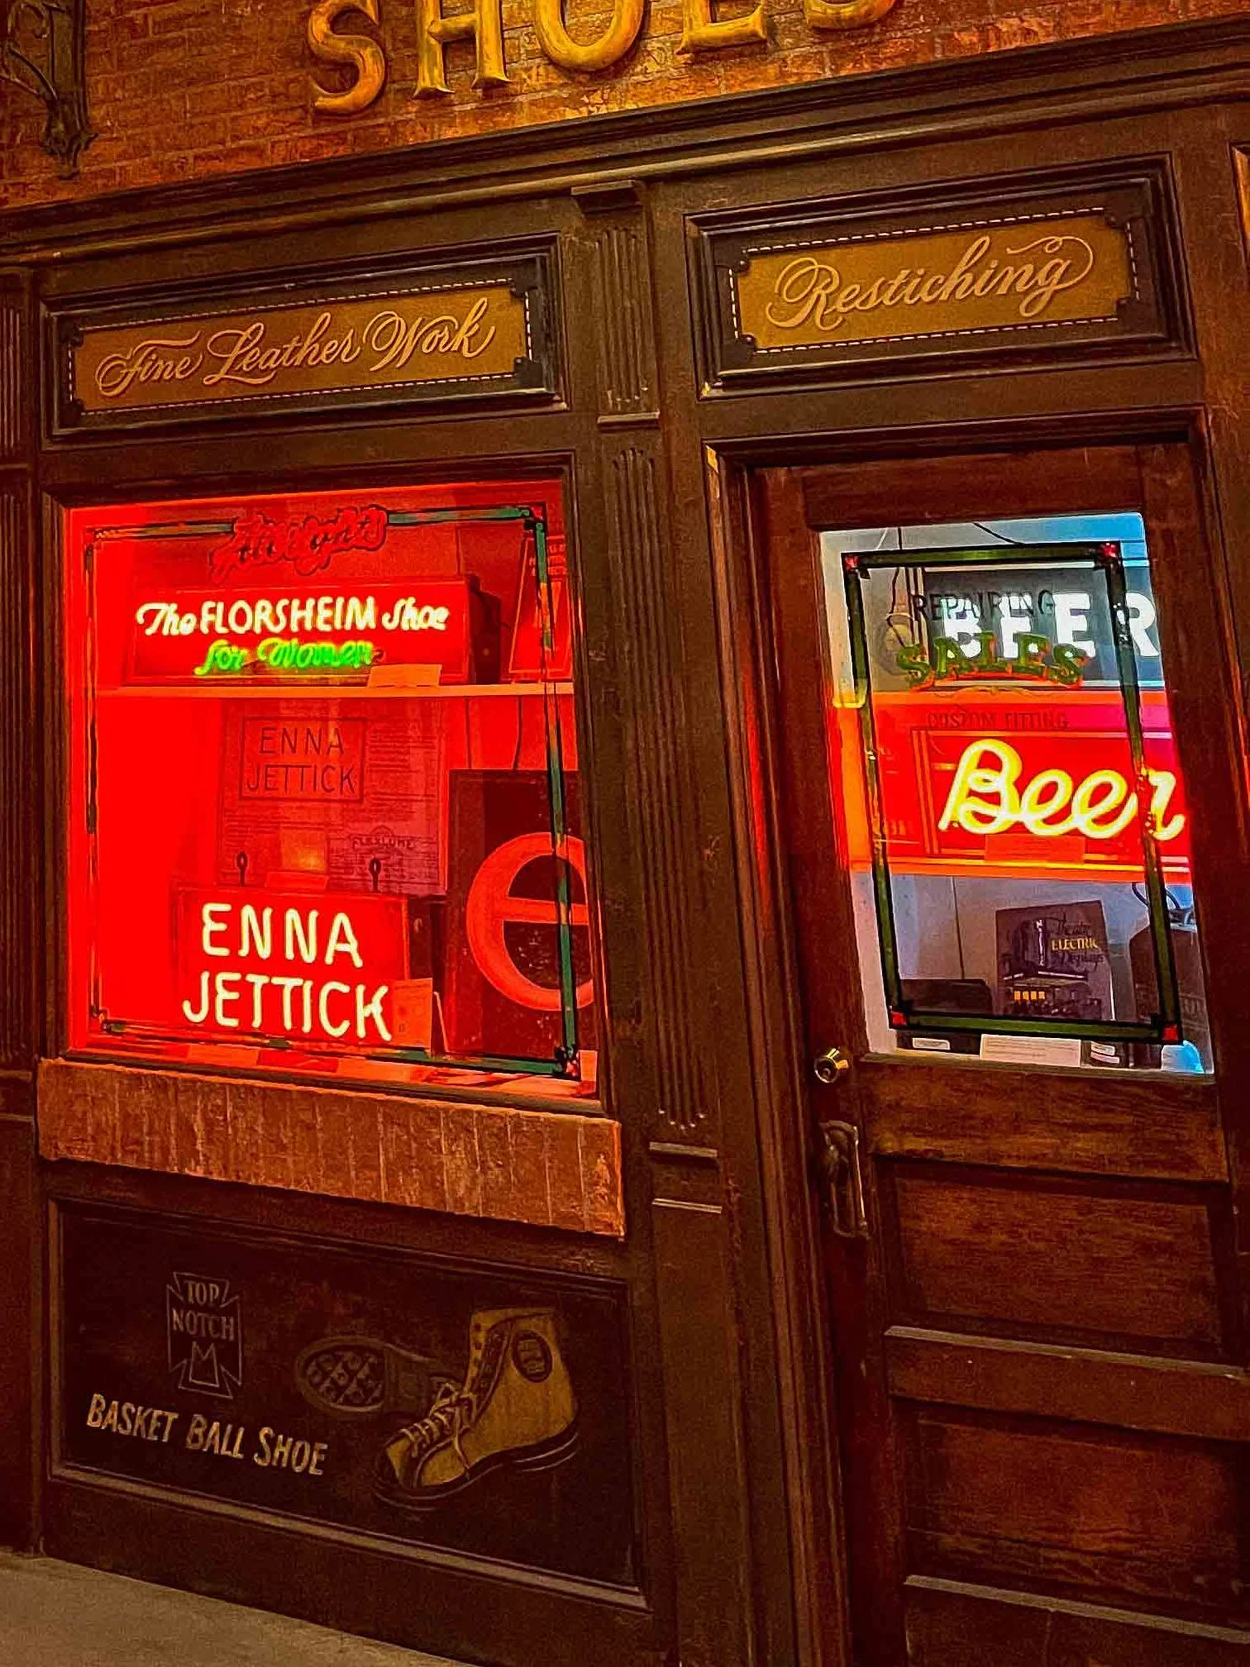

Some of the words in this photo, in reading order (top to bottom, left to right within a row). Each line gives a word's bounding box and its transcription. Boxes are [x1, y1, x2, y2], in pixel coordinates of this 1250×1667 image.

[766, 235, 1094, 331] Restiching
[95, 329, 202, 397] Fine
[203, 312, 361, 386] Leather
[362, 297, 496, 372] Work
[136, 602, 198, 636] The
[199, 596, 376, 635] FLORSHEIM
[381, 596, 450, 631] Shoe
[896, 631, 1085, 686] SALES
[260, 727, 344, 755] ENNA
[247, 765, 355, 795] JETTICK
[938, 739, 1186, 840] Beer
[201, 903, 363, 968] ENNA
[182, 971, 393, 1041] JETTICK
[186, 1280, 220, 1306] TOP
[171, 1310, 235, 1341] NOTCH
[86, 1393, 179, 1442] BASKET
[187, 1414, 245, 1458] BALL
[254, 1427, 329, 1475] SHOE
